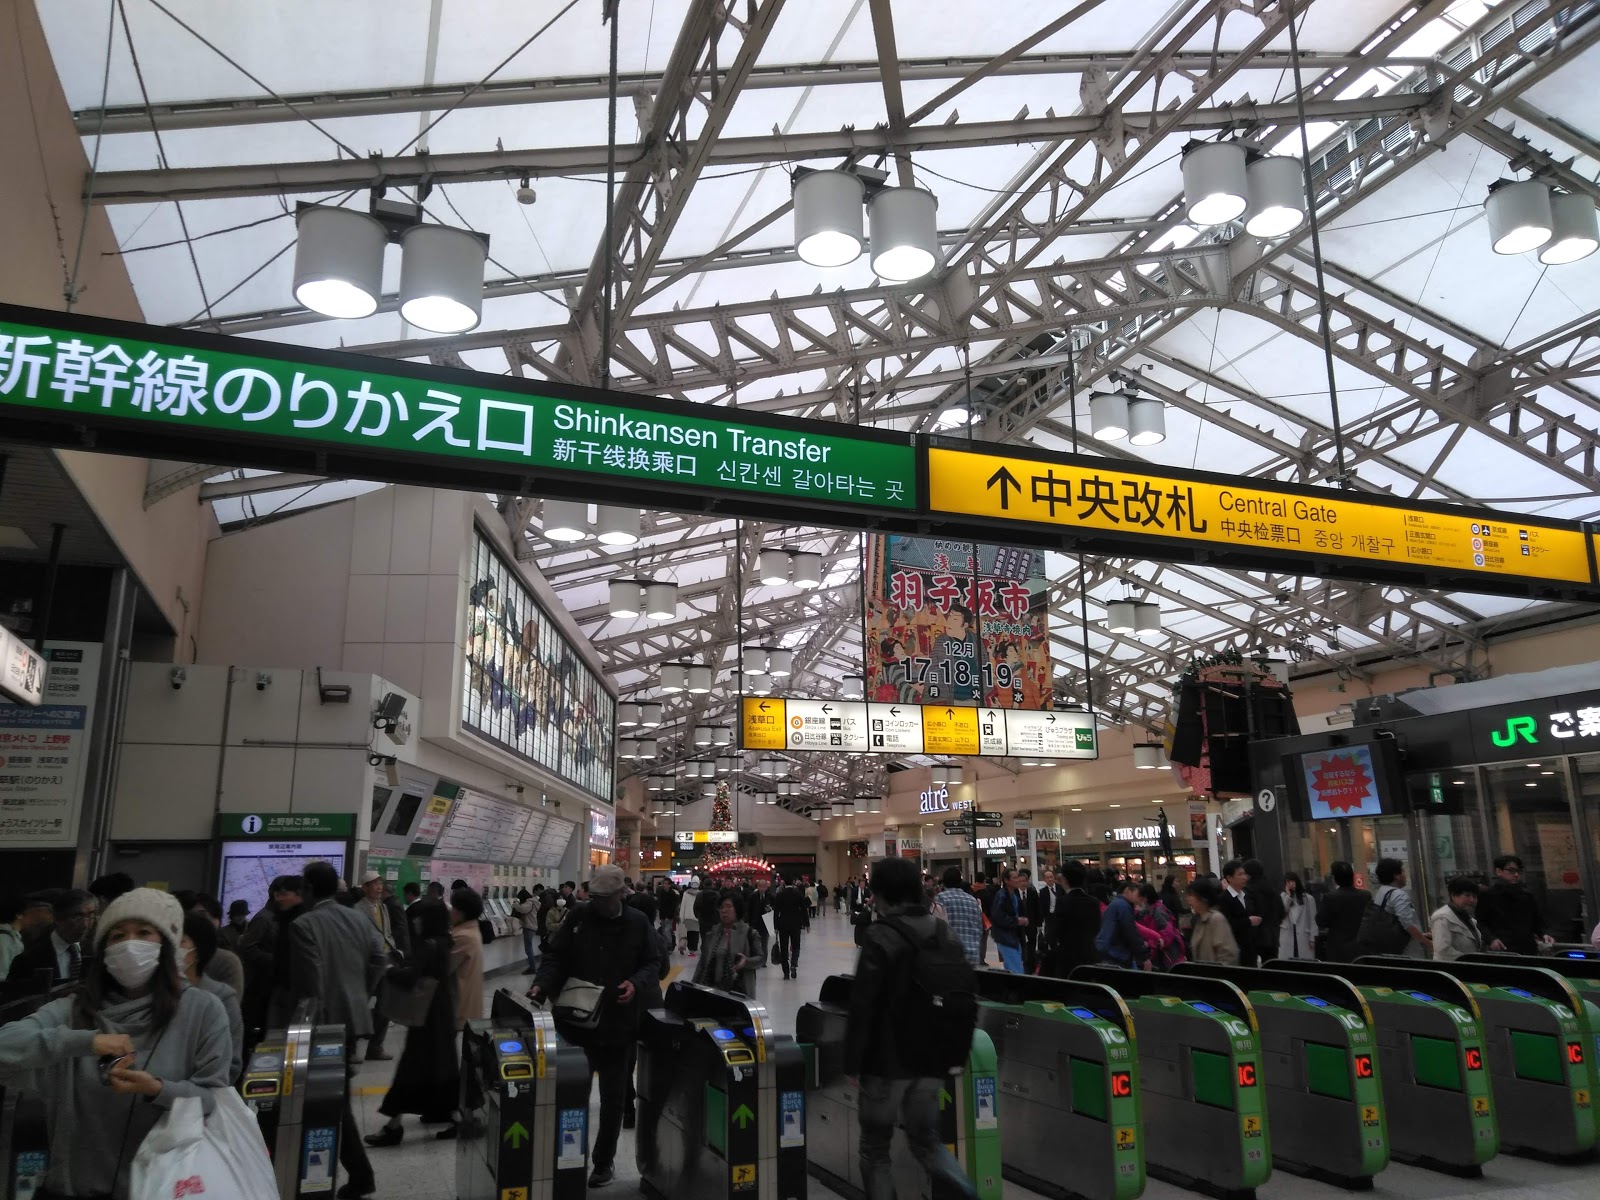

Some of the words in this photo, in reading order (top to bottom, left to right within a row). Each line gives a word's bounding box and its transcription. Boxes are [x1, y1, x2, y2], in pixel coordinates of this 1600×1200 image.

[0, 334, 534, 457] 新幹線のりかえ口
[554, 404, 718, 450] Shinkansen
[726, 428, 831, 464] Transfer
[552, 437, 697, 477] 新干线换乘口
[716, 459, 782, 488] 신칸센
[791, 467, 876, 498] 갈아타는
[884, 479, 905, 501] 곳
[1030, 468, 1208, 534] 中央改札
[1218, 491, 1287, 518] Central
[1293, 500, 1338, 524] Gate
[1220, 517, 1301, 545] 中央检票口
[1313, 529, 1344, 550] 중앙
[1351, 533, 1396, 556] 개찰구
[890, 570, 1032, 620] 羽子板市
[943, 641, 975, 658] 12月
[747, 714, 775, 725] 浅草口
[804, 716, 826, 725] 銀座線
[842, 718, 857, 726] バス
[884, 719, 919, 728] コインロッカー
[804, 732, 827, 741] 日比谷線
[843, 733, 864, 741] タクシー
[885, 734, 900, 743] 電話
[1491, 715, 1540, 748] JR
[919, 783, 949, 812] atré
[952, 799, 973, 810] WEST
[267, 817, 320, 826] 上野駅ご案内
[1113, 828, 1133, 841] THE
[1135, 825, 1176, 840] GARDN
[976, 838, 989, 849] THE
[989, 836, 1017, 849] GARDEN
[1448, 1007, 1473, 1024] IC
[1549, 1003, 1574, 1020] IC
[1223, 1019, 1249, 1037] IC
[1339, 1013, 1364, 1030] IC
[1099, 1027, 1126, 1045] IC
[1465, 1050, 1482, 1069] IC
[1567, 1044, 1583, 1063] IC
[1237, 1065, 1256, 1086] IC
[1354, 1056, 1372, 1077] IC
[1111, 1073, 1131, 1096] IC
